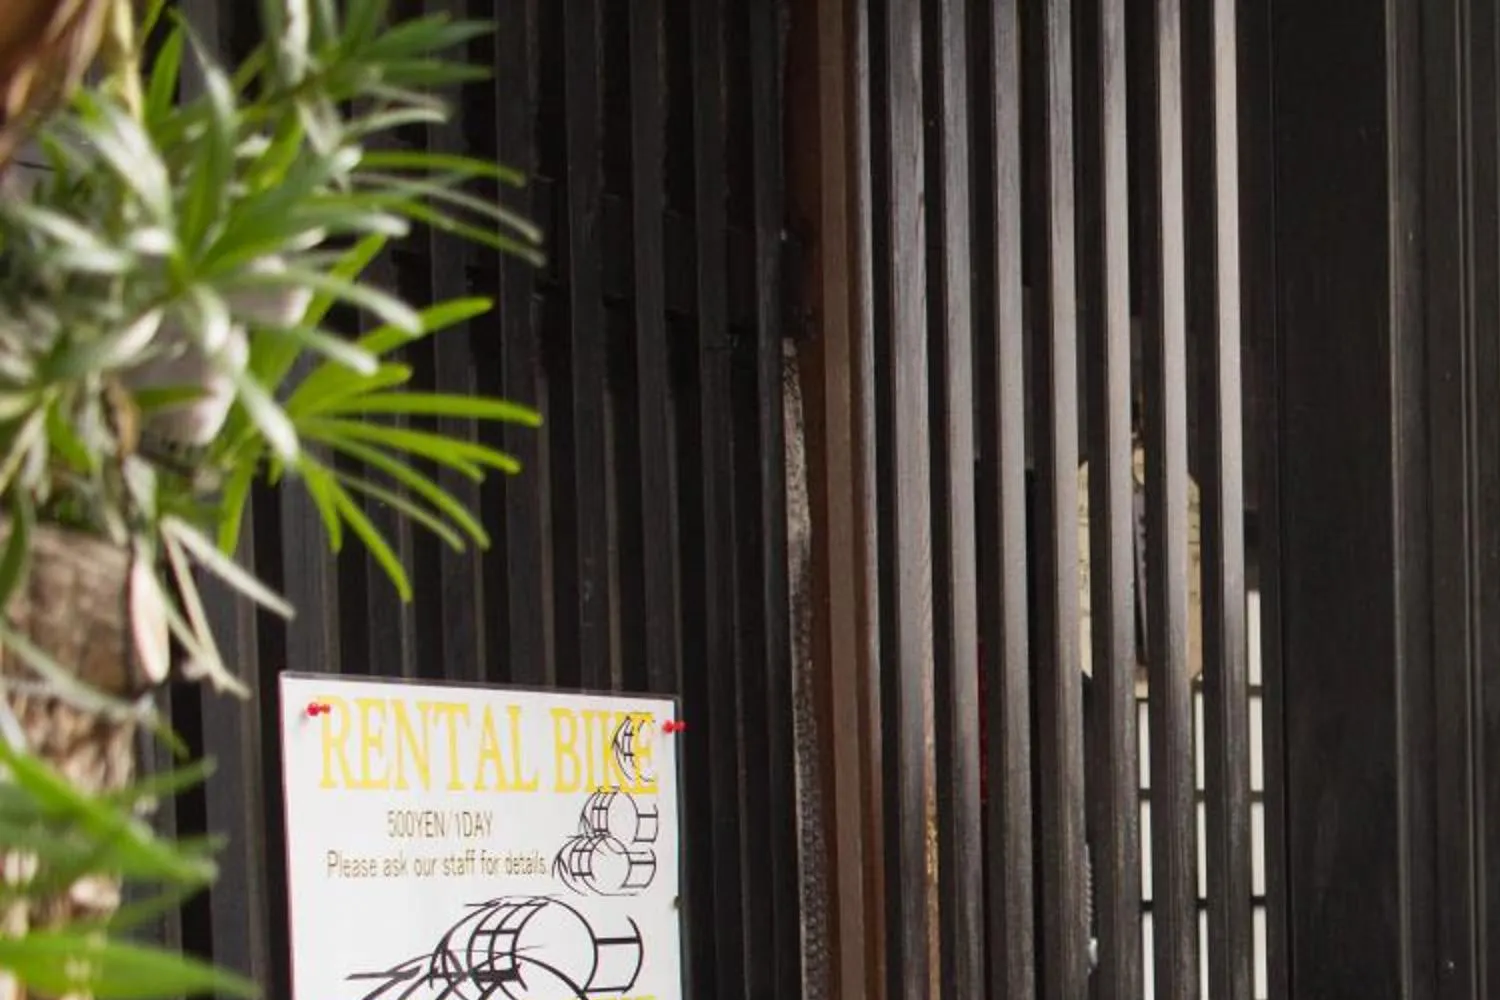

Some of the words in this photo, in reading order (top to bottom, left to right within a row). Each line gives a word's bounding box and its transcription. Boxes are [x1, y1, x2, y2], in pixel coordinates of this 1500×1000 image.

[317, 696, 540, 794] RENTAL
[549, 707, 659, 796] BIKE
[326, 849, 378, 878] Please
[383, 850, 407, 878] ask
[413, 857, 437, 877] our
[442, 848, 476, 877] staff
[480, 848, 500, 876] for
